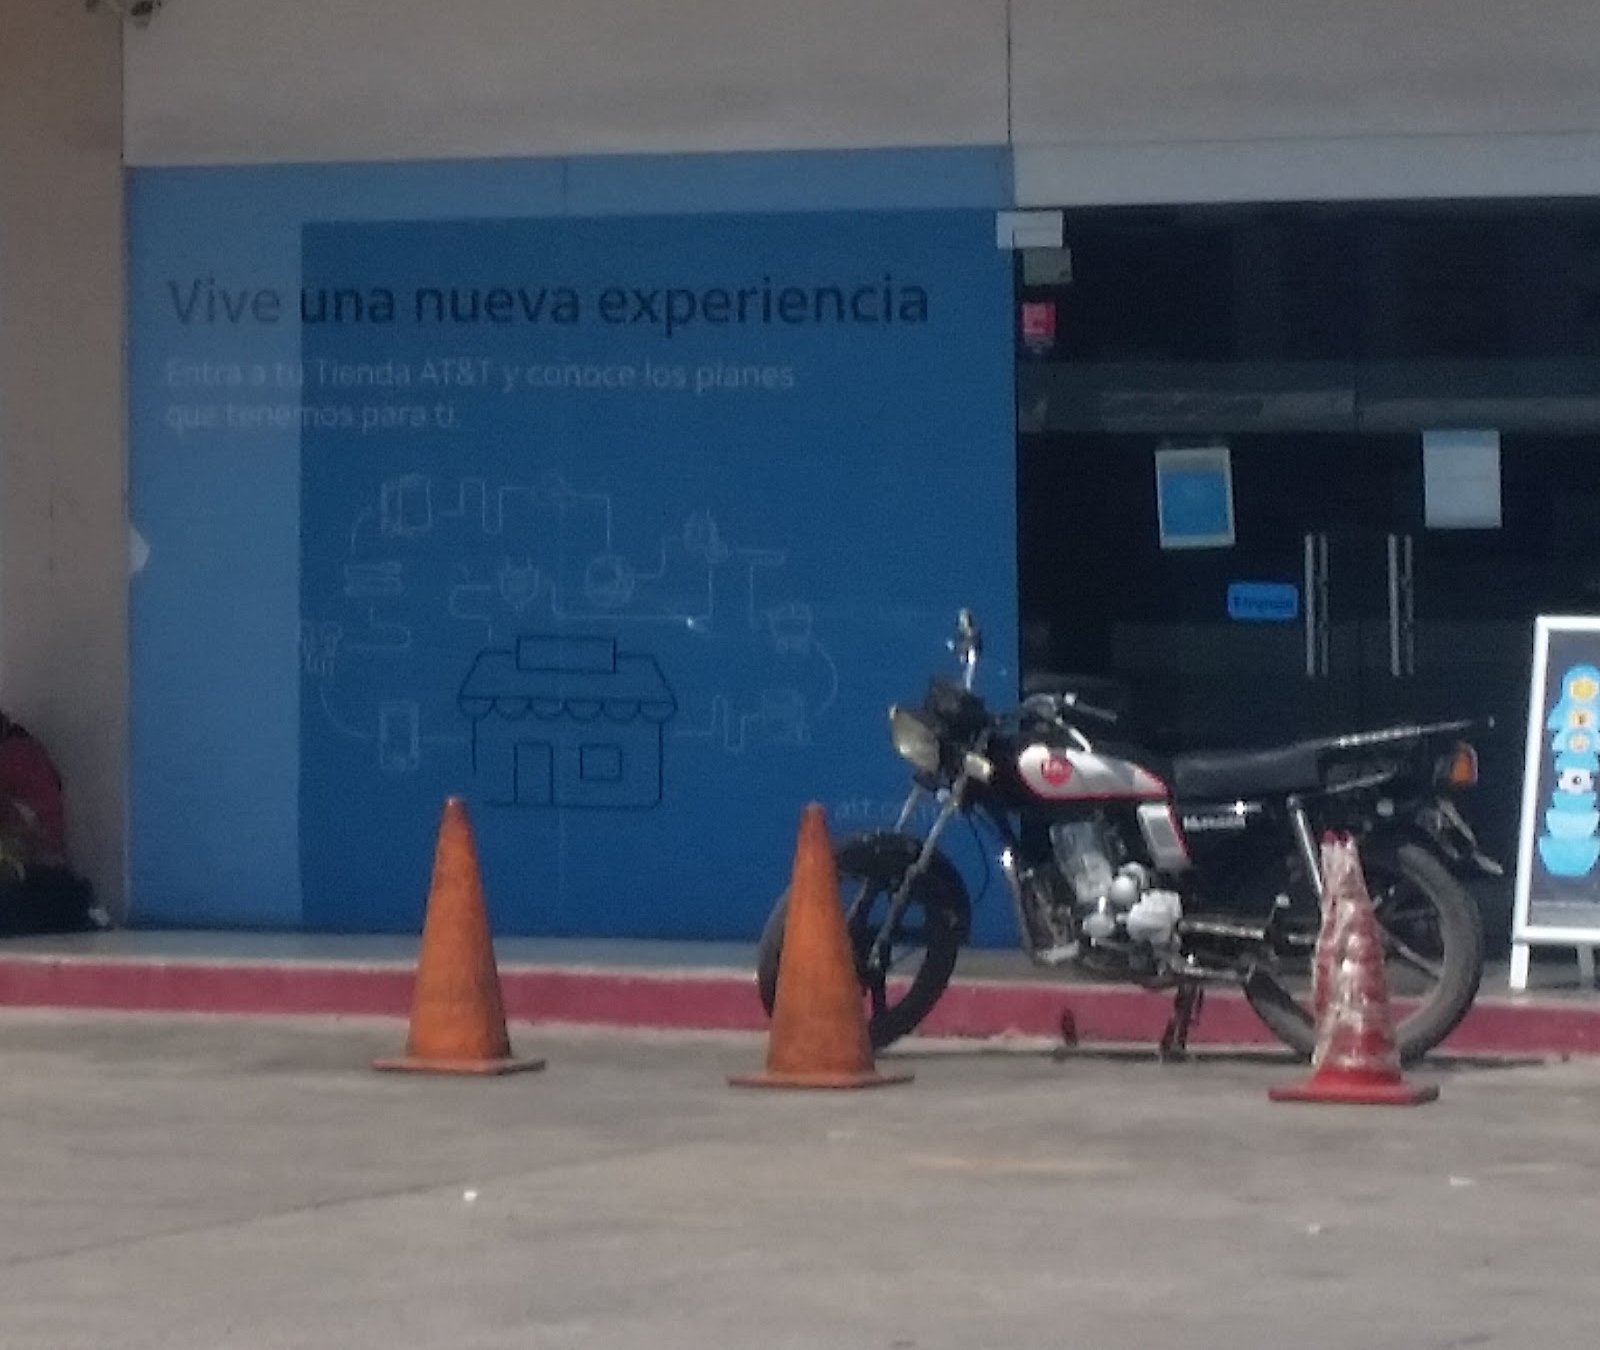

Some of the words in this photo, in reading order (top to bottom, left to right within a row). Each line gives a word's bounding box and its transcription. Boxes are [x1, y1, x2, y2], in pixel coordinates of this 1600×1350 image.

[167, 272, 281, 325] Vive
[300, 286, 395, 324] una
[414, 286, 580, 324] nueva
[598, 273, 929, 338] experiencia
[316, 357, 412, 387] Tienda
[421, 358, 493, 387] AT&T
[501, 365, 518, 393] y
[527, 363, 637, 388] conoce
[645, 359, 687, 389] los
[695, 359, 796, 395] planes
